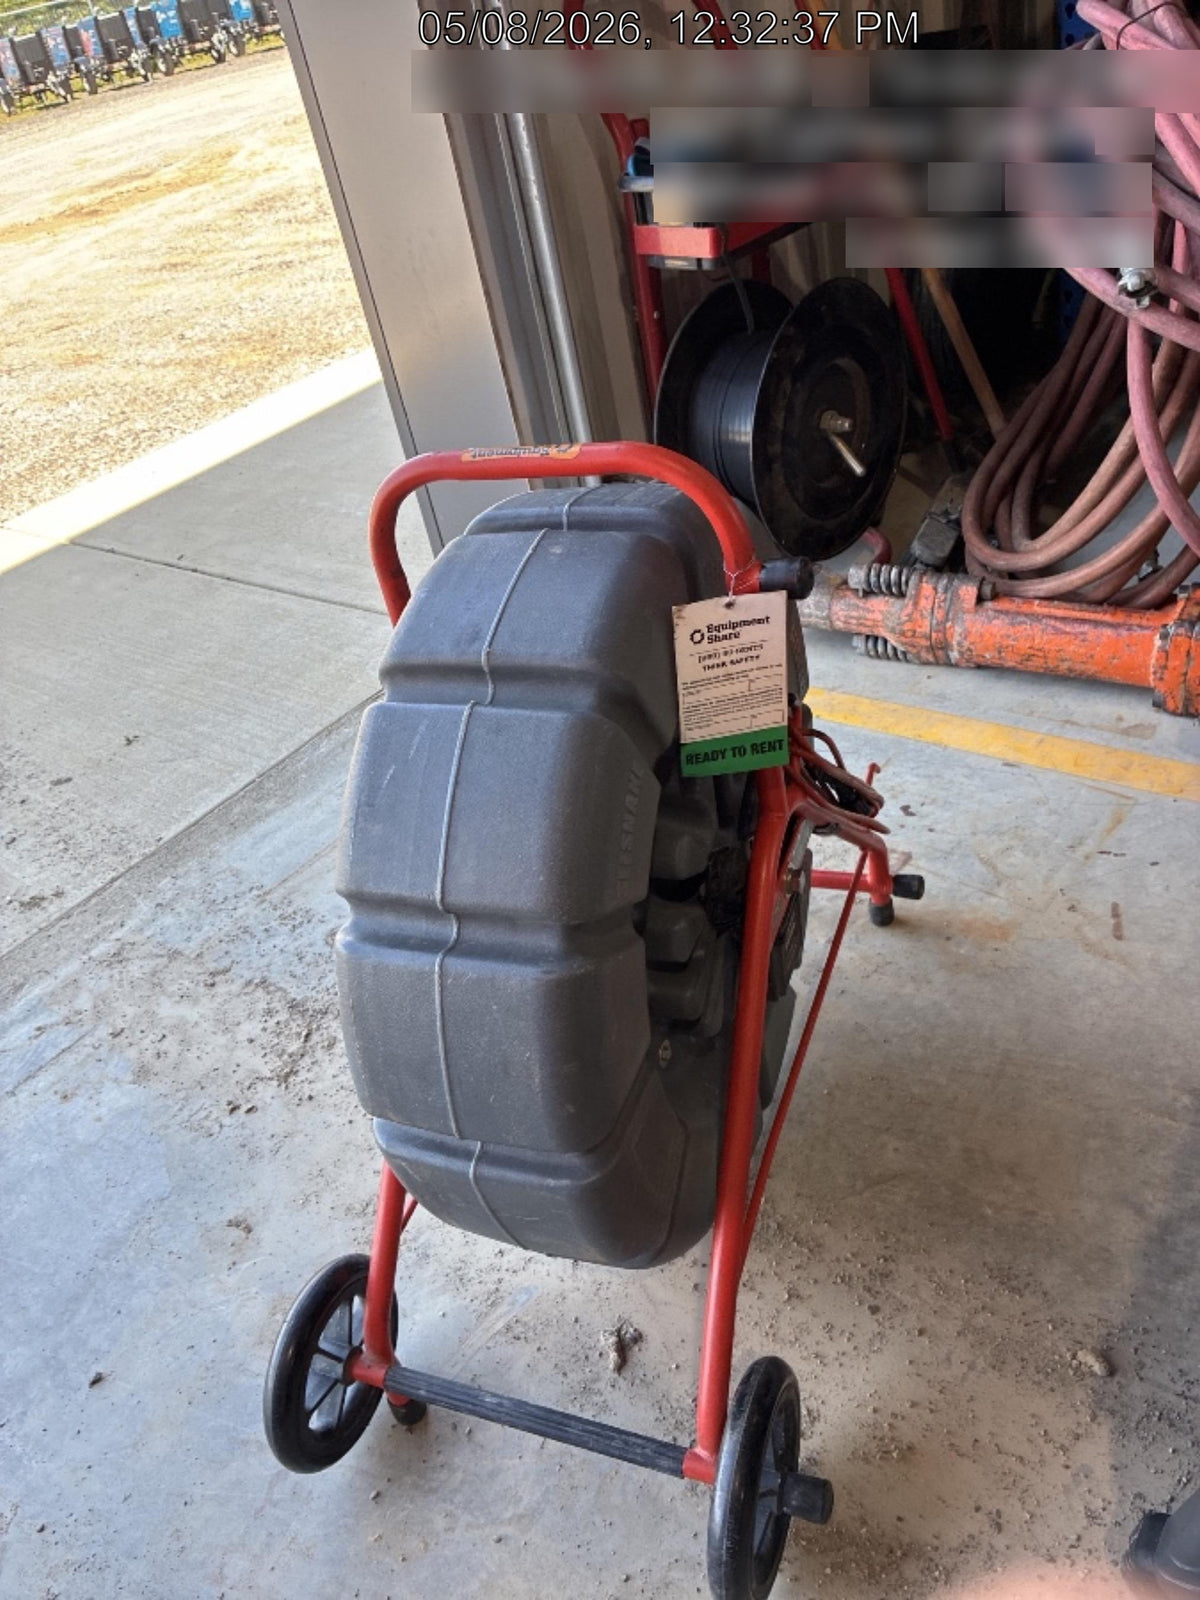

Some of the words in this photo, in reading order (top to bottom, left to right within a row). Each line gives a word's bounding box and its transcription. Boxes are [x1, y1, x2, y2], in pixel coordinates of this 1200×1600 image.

[706, 615, 770, 633] Equipment
[706, 631, 741, 645] Share
[685, 747, 728, 766] READY
[731, 744, 747, 759] TO
[750, 739, 785, 756] RENT
